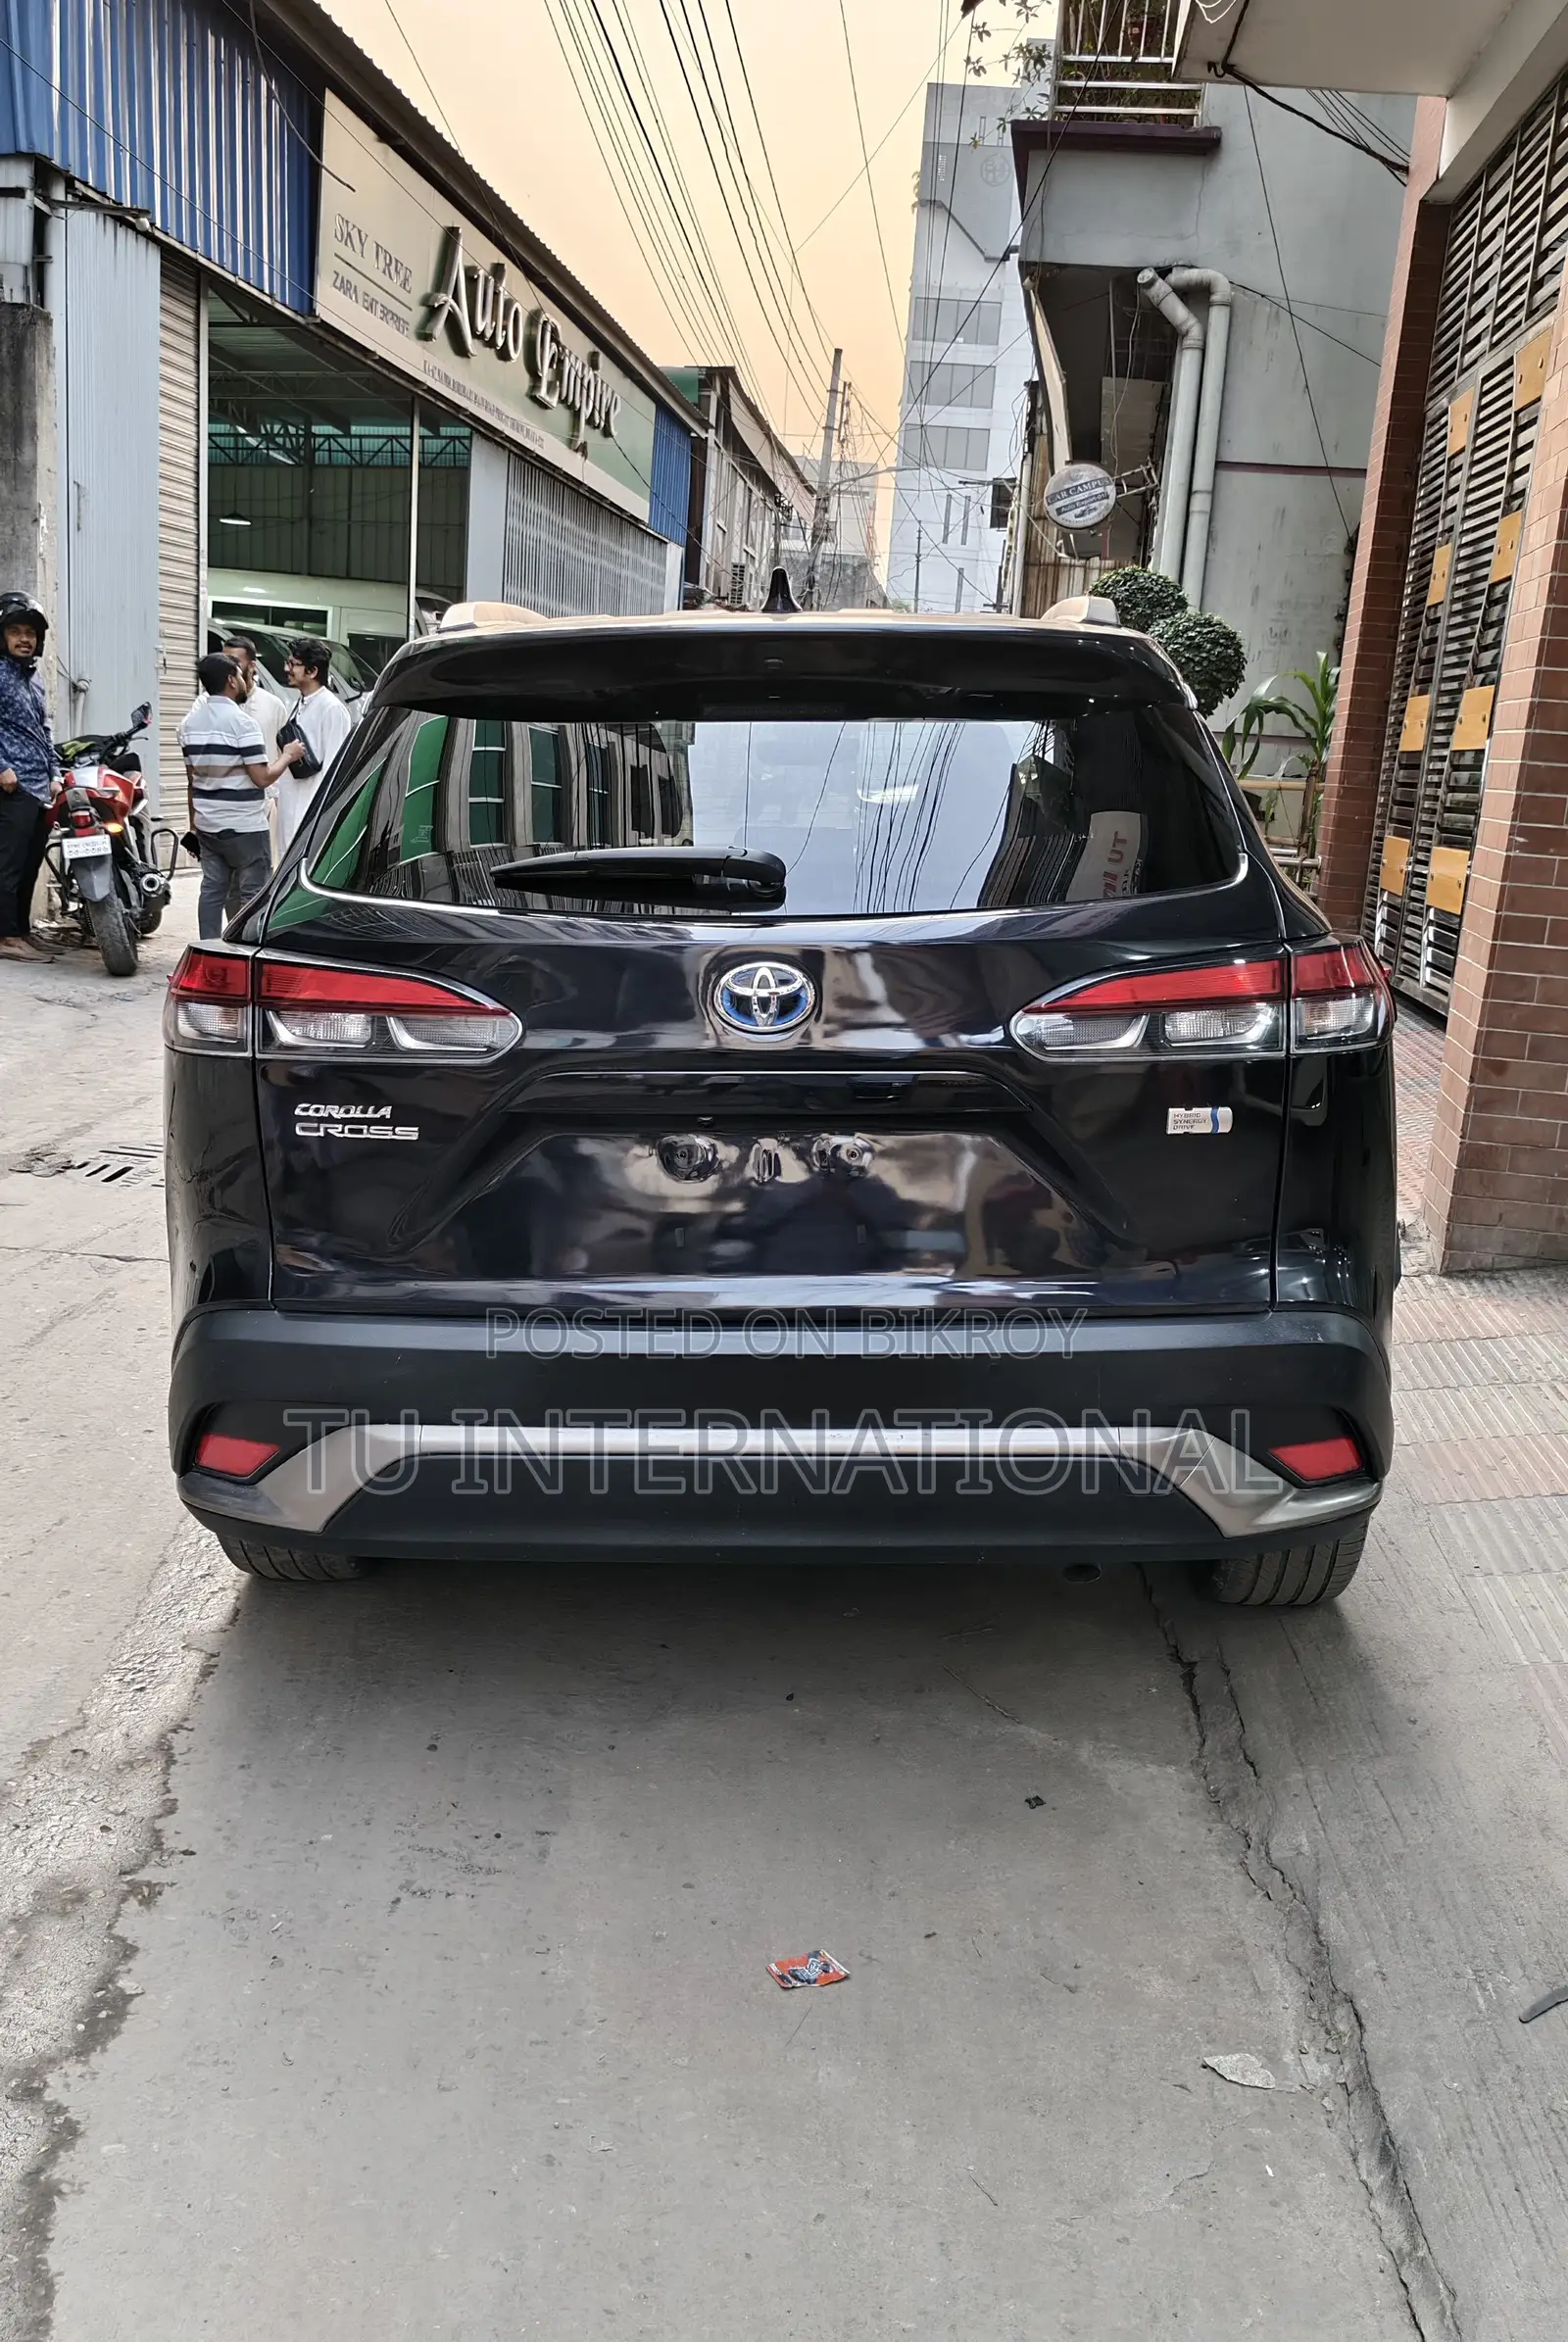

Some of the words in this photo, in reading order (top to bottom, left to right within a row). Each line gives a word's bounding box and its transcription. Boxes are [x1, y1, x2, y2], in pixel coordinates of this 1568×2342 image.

[333, 213, 368, 259] SKY
[373, 240, 412, 294] TREE
[332, 269, 359, 305] ZARA
[423, 226, 523, 364] Auto
[1048, 492, 1068, 504] CAR
[1069, 477, 1110, 495] CAMPUS
[294, 1102, 393, 1119] COROLLA
[295, 1122, 419, 1141] CROSS
